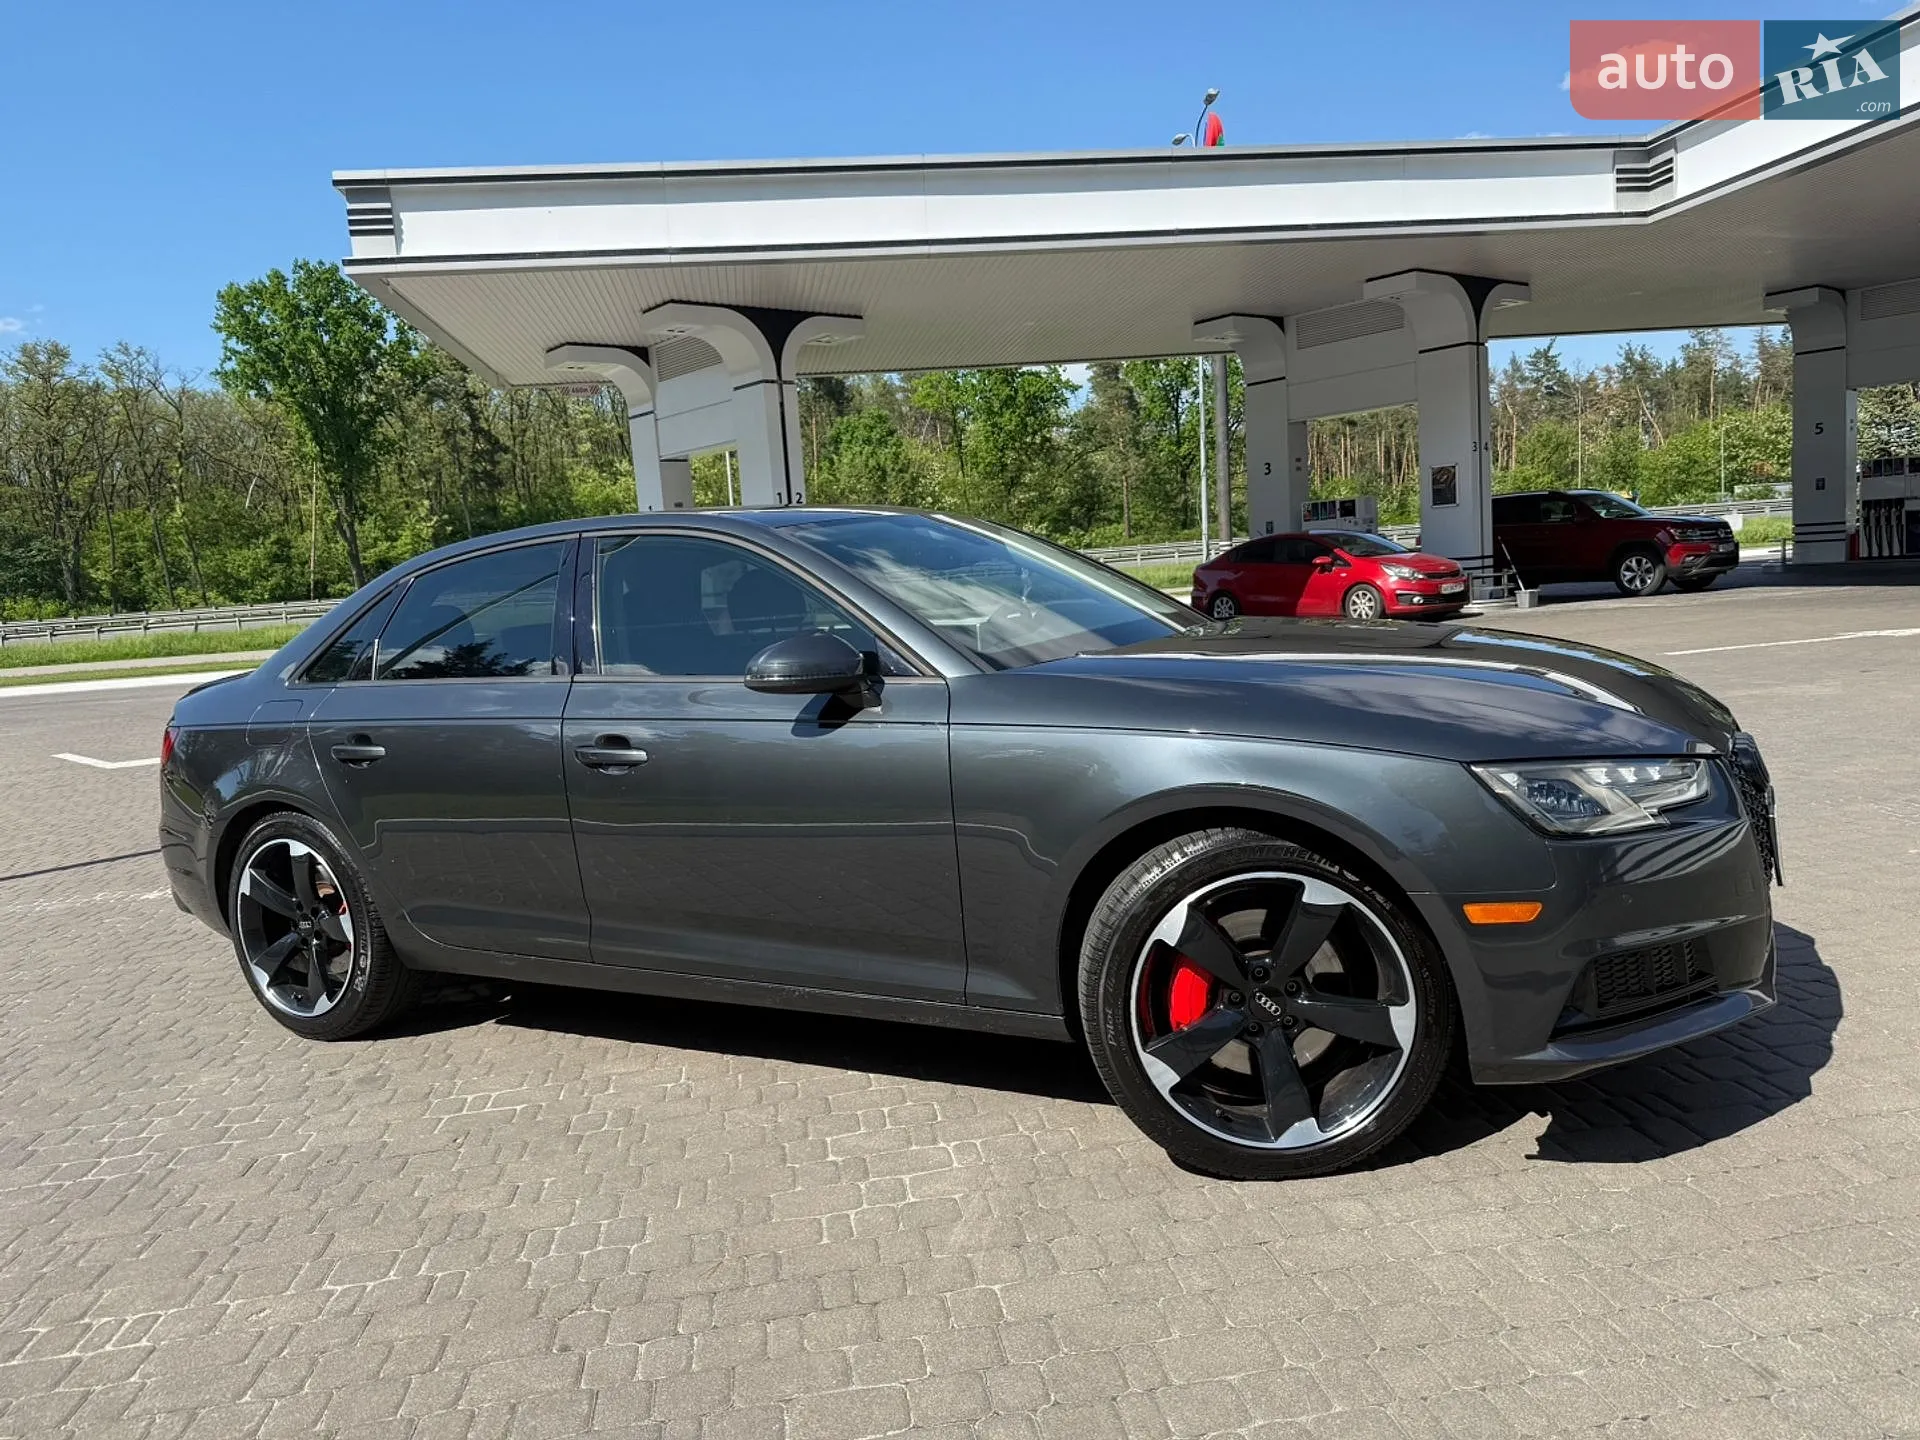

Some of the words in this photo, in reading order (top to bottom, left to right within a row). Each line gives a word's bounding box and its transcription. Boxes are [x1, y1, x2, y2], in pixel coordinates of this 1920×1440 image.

[1815, 422, 1824, 435] 5
[1472, 441, 1477, 452] 3
[1483, 441, 1488, 452] 4
[1264, 462, 1271, 476] 3
[776, 492, 782, 504] 1
[796, 492, 803, 504] 2
